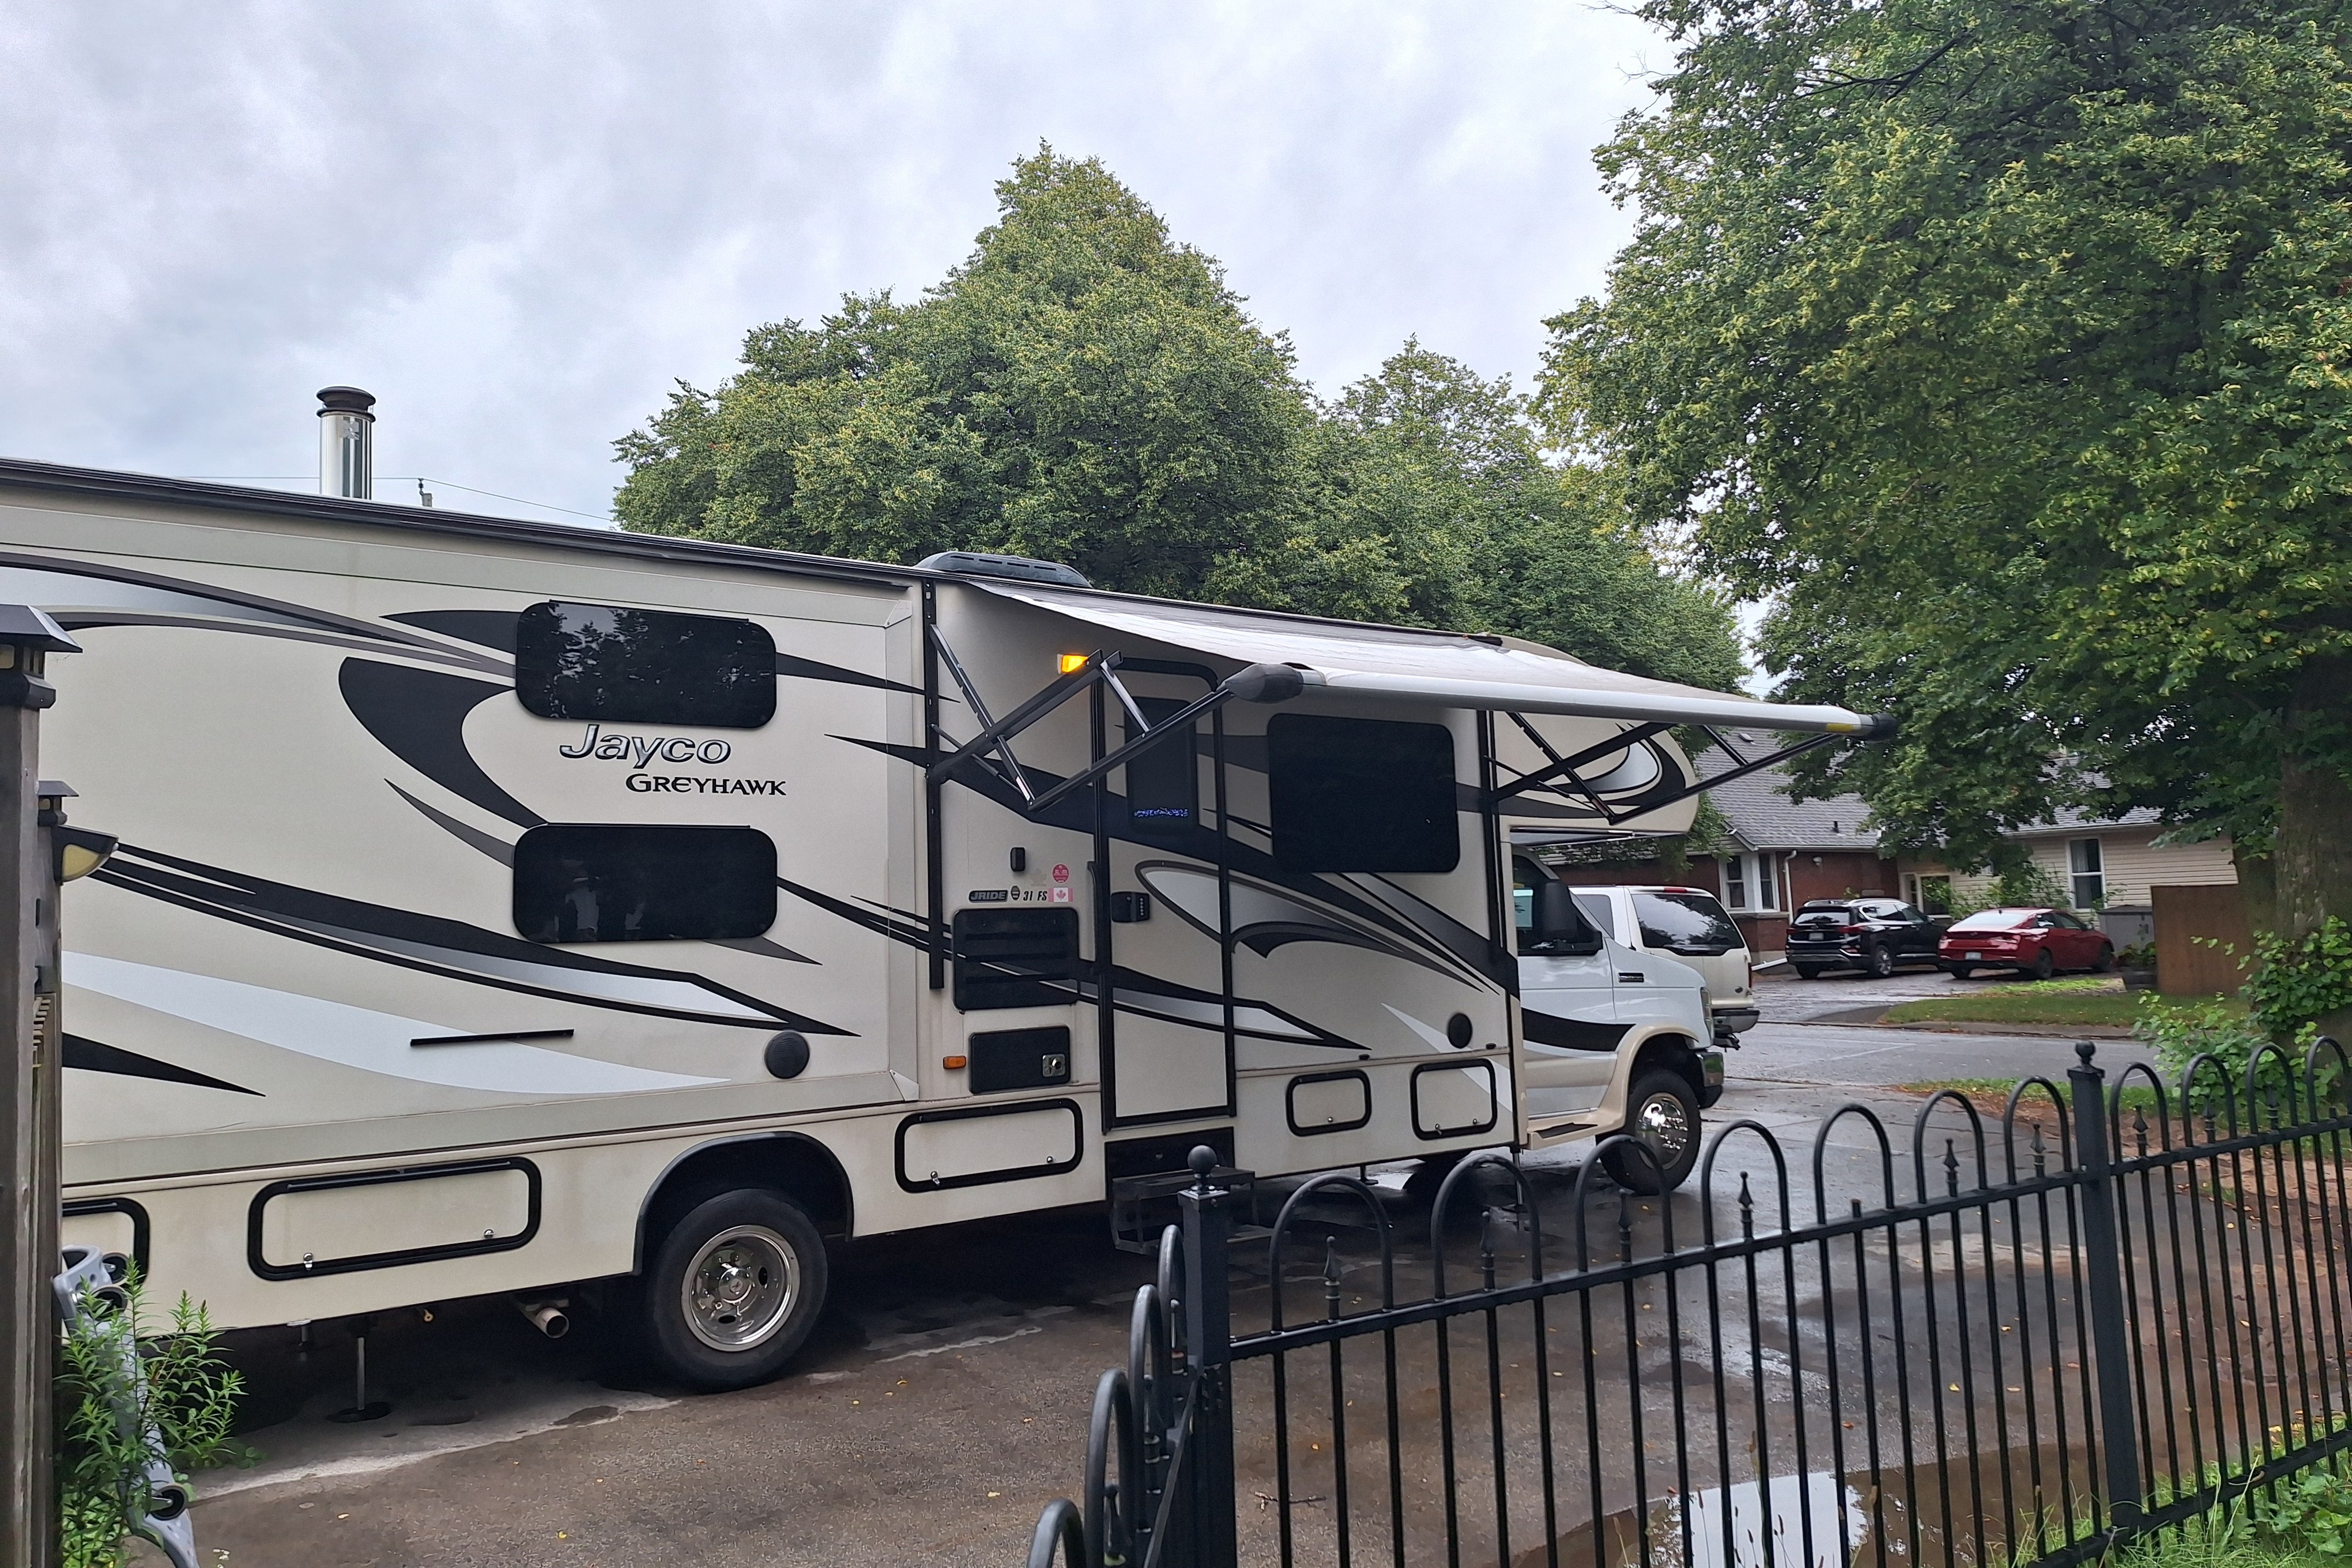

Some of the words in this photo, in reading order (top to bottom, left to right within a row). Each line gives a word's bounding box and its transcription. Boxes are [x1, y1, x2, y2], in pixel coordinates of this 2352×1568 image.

[559, 723, 732, 769] Jayco
[625, 773, 787, 796] GREYHAWK
[970, 891, 1006, 900] JRIDE
[1023, 891, 1033, 901] 31
[1037, 891, 1048, 901] FS
